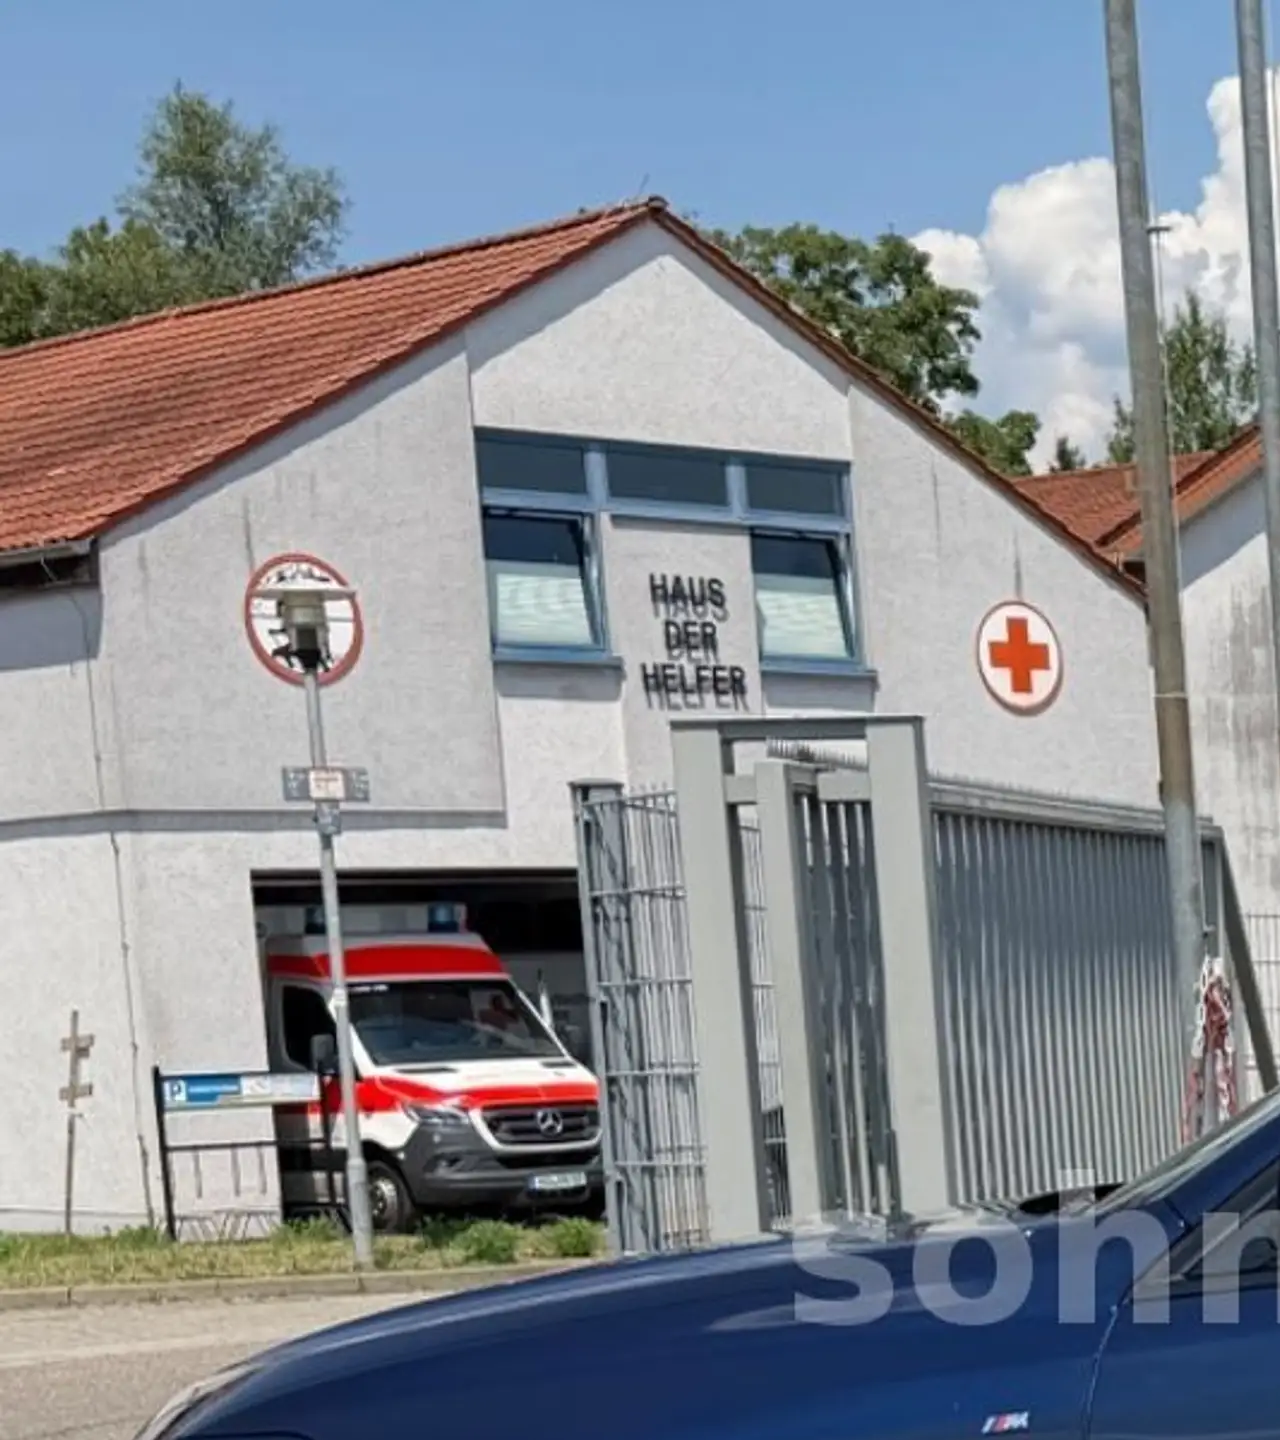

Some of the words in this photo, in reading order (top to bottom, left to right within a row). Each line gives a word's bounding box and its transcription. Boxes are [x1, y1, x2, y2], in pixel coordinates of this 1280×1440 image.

[649, 572, 727, 609] HAUS
[664, 619, 718, 652] DER
[640, 661, 747, 695] HELFER
